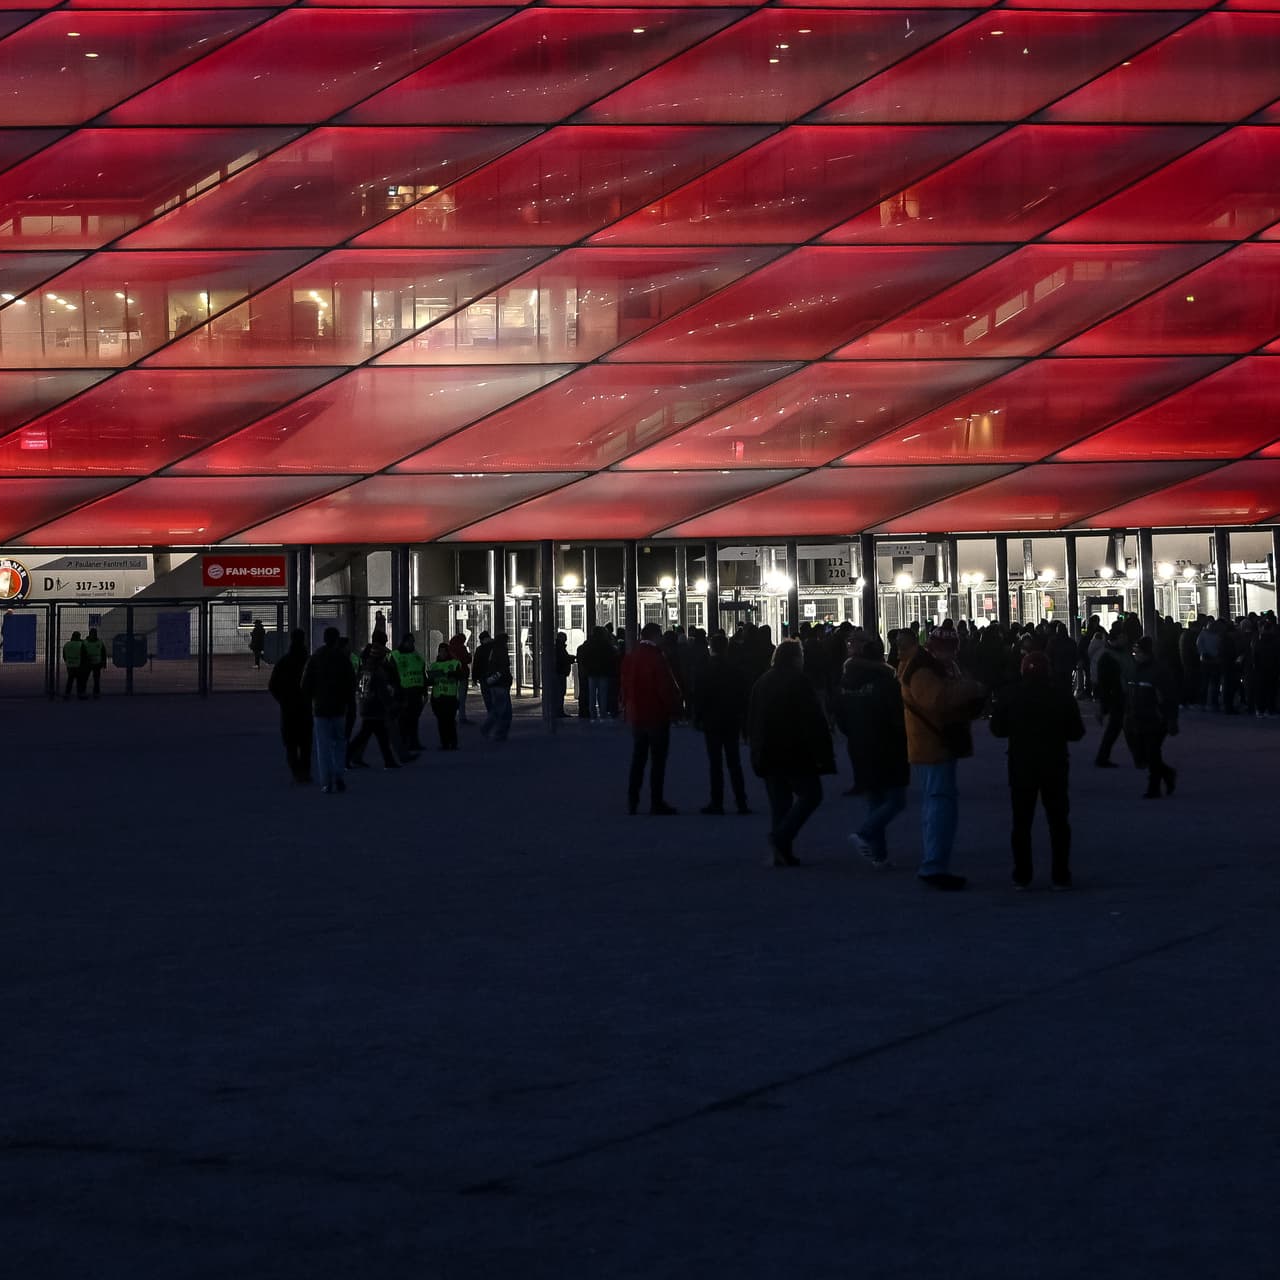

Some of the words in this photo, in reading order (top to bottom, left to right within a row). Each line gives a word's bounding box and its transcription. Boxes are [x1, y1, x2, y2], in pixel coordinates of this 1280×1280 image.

[225, 567, 281, 576] FAN-SHOP
[44, 577, 54, 592] D
[75, 581, 116, 591] 317-319
